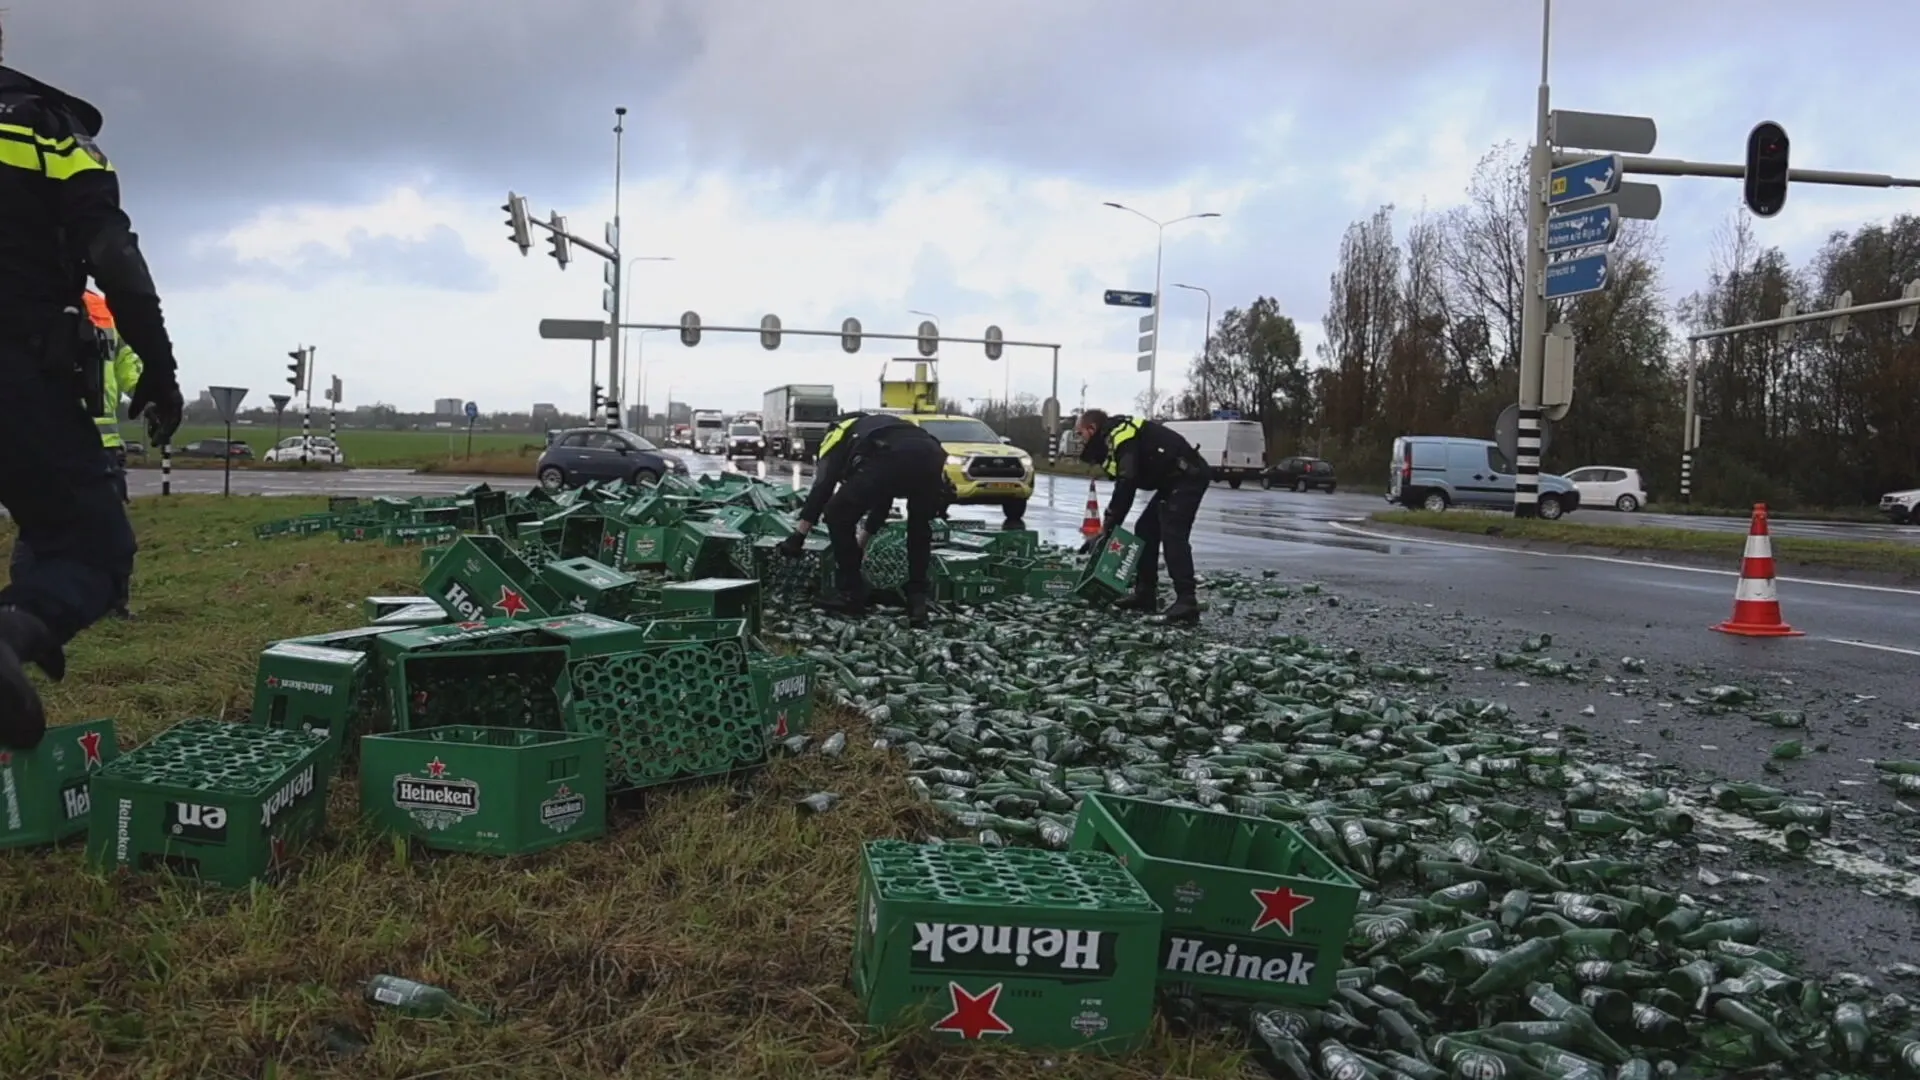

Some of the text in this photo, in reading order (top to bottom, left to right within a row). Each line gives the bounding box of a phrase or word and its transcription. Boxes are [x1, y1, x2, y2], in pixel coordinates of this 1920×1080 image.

[1115, 541, 1139, 581] Heinek
[260, 763, 314, 828] Heinek
[400, 782, 474, 806] Heineken
[117, 799, 132, 860] Heineken
[912, 922, 1100, 969] Heinek
[1166, 937, 1315, 985] Heinek
